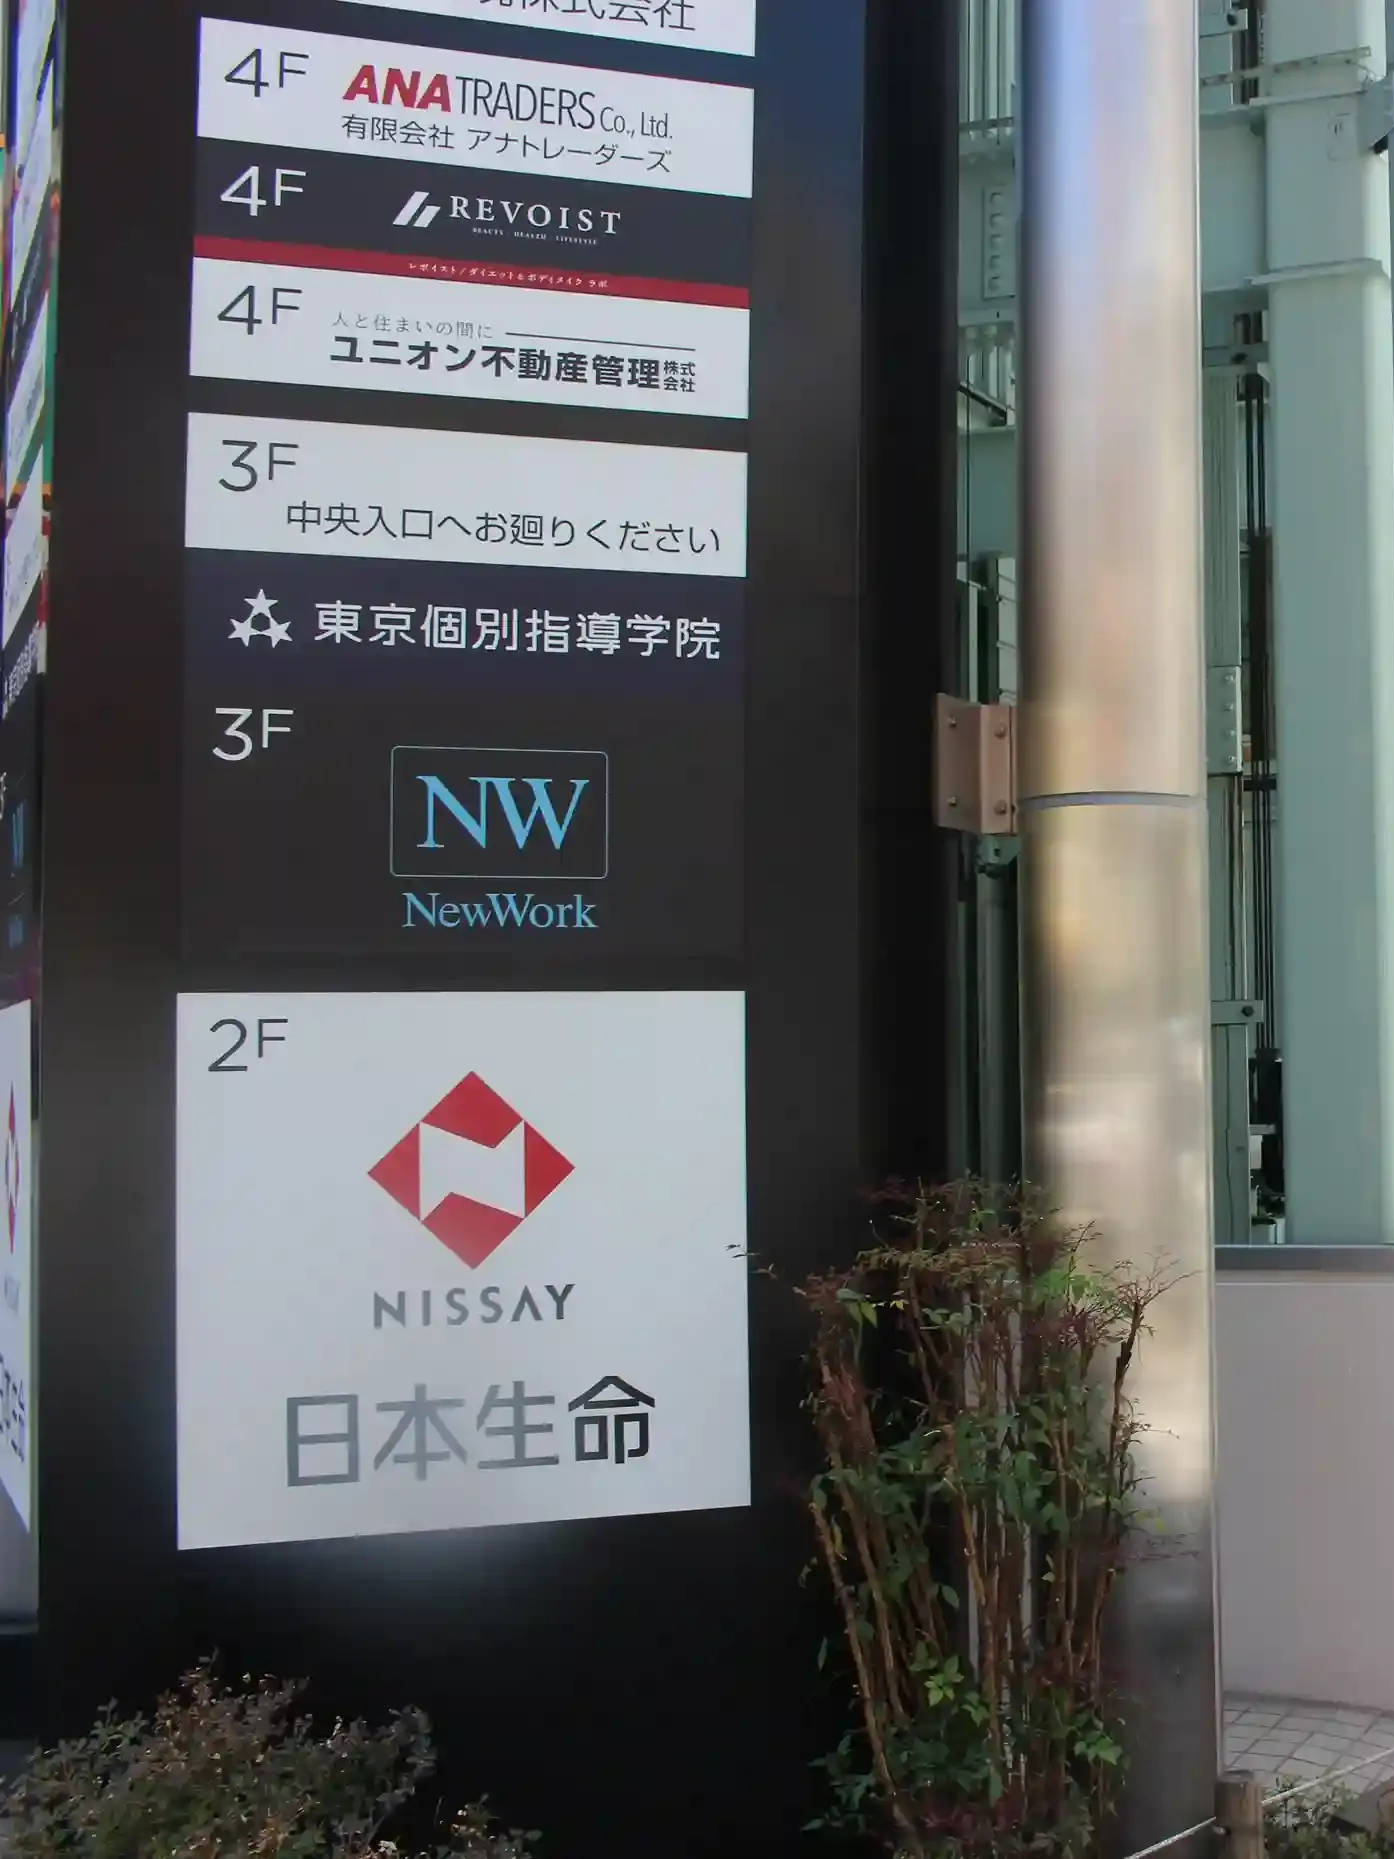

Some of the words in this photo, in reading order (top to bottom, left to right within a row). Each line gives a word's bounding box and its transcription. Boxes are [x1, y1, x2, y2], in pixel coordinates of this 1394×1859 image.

[224, 48, 309, 98] 4F
[341, 114, 455, 149] 有限会社
[467, 128, 672, 173] アナトレーダーズ
[640, 112, 673, 139] Ltd.
[220, 165, 307, 216] 4F
[450, 195, 621, 235] REVOIST
[217, 284, 303, 336] 4F
[331, 311, 493, 340] 人と住まいの間に
[218, 439, 299, 493] 3F
[286, 500, 721, 555] 中央入口へお廻りください
[313, 600, 721, 660] 東京個別指導学院
[212, 707, 295, 762] 3F
[416, 775, 590, 850] NW
[402, 892, 598, 928] NewWork
[207, 1016, 289, 1072] 2F
[373, 1283, 576, 1330] NISSAY
[285, 1375, 656, 1488] 日本生命
